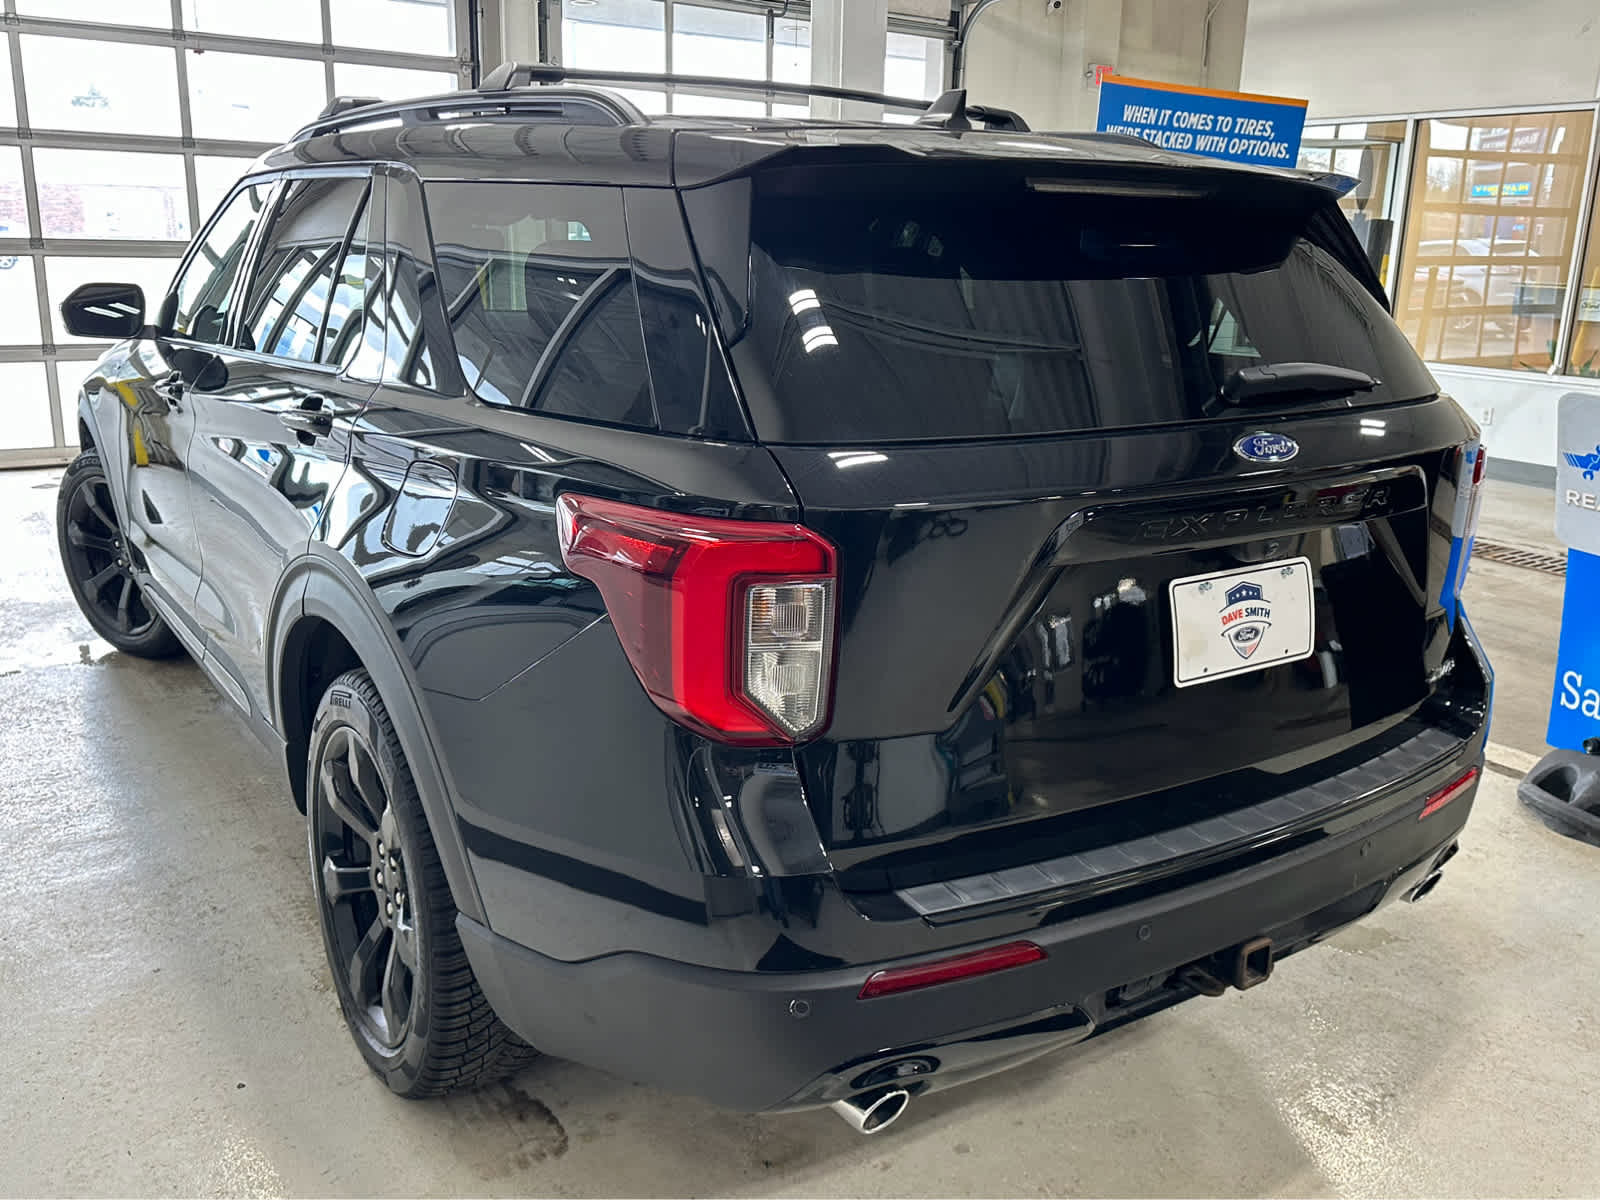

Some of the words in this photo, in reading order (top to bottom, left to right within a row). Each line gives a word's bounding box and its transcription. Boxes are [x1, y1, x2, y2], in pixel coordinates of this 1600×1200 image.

[1123, 104, 1158, 125] WHEN
[1158, 109, 1172, 126] IT
[1173, 111, 1214, 131] COMES
[1216, 115, 1232, 133] TO
[1234, 117, 1275, 140] TIRES,
[1143, 128, 1193, 150] STACKED
[1195, 134, 1228, 153] WITH
[1228, 138, 1290, 159] OPTIONS.
[1253, 437, 1287, 455] Ford
[1566, 489, 1600, 511] RE
[1139, 487, 1388, 538] EXPLORER
[1222, 609, 1243, 625] DAVE
[1245, 607, 1270, 618] SMITH
[330, 690, 352, 709] PIRELLI
